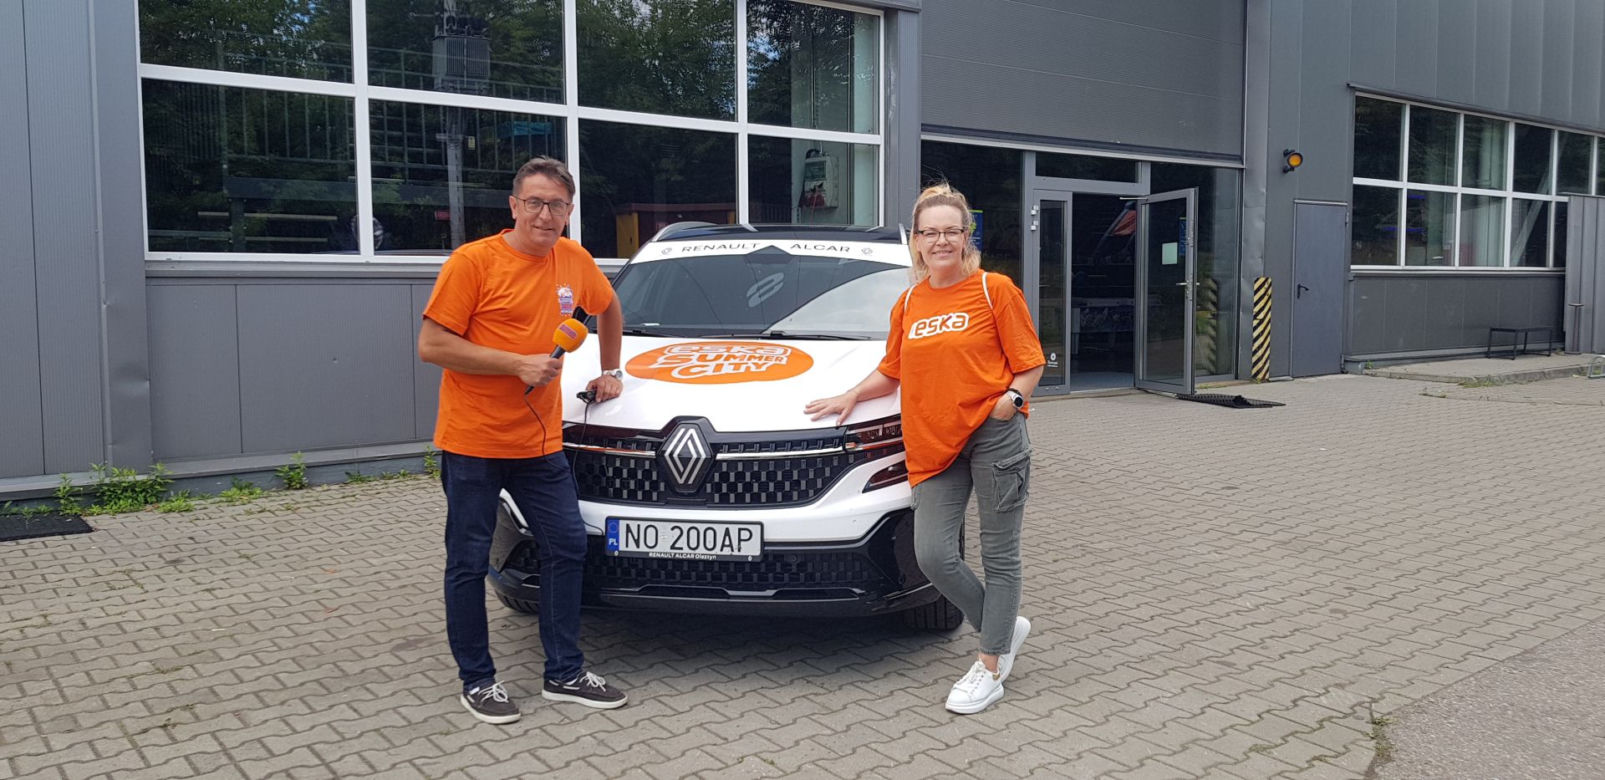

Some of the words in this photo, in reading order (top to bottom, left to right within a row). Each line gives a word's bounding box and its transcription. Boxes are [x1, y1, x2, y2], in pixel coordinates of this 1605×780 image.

[682, 242, 760, 252] RENAULT
[791, 243, 850, 252] ALCAR
[912, 313, 968, 337] eska
[669, 344, 786, 356] eska
[657, 354, 785, 366] SUMMER
[674, 362, 769, 377] CITY
[608, 537, 618, 546] PL
[625, 523, 659, 549] NO
[670, 525, 753, 553] 200AP
